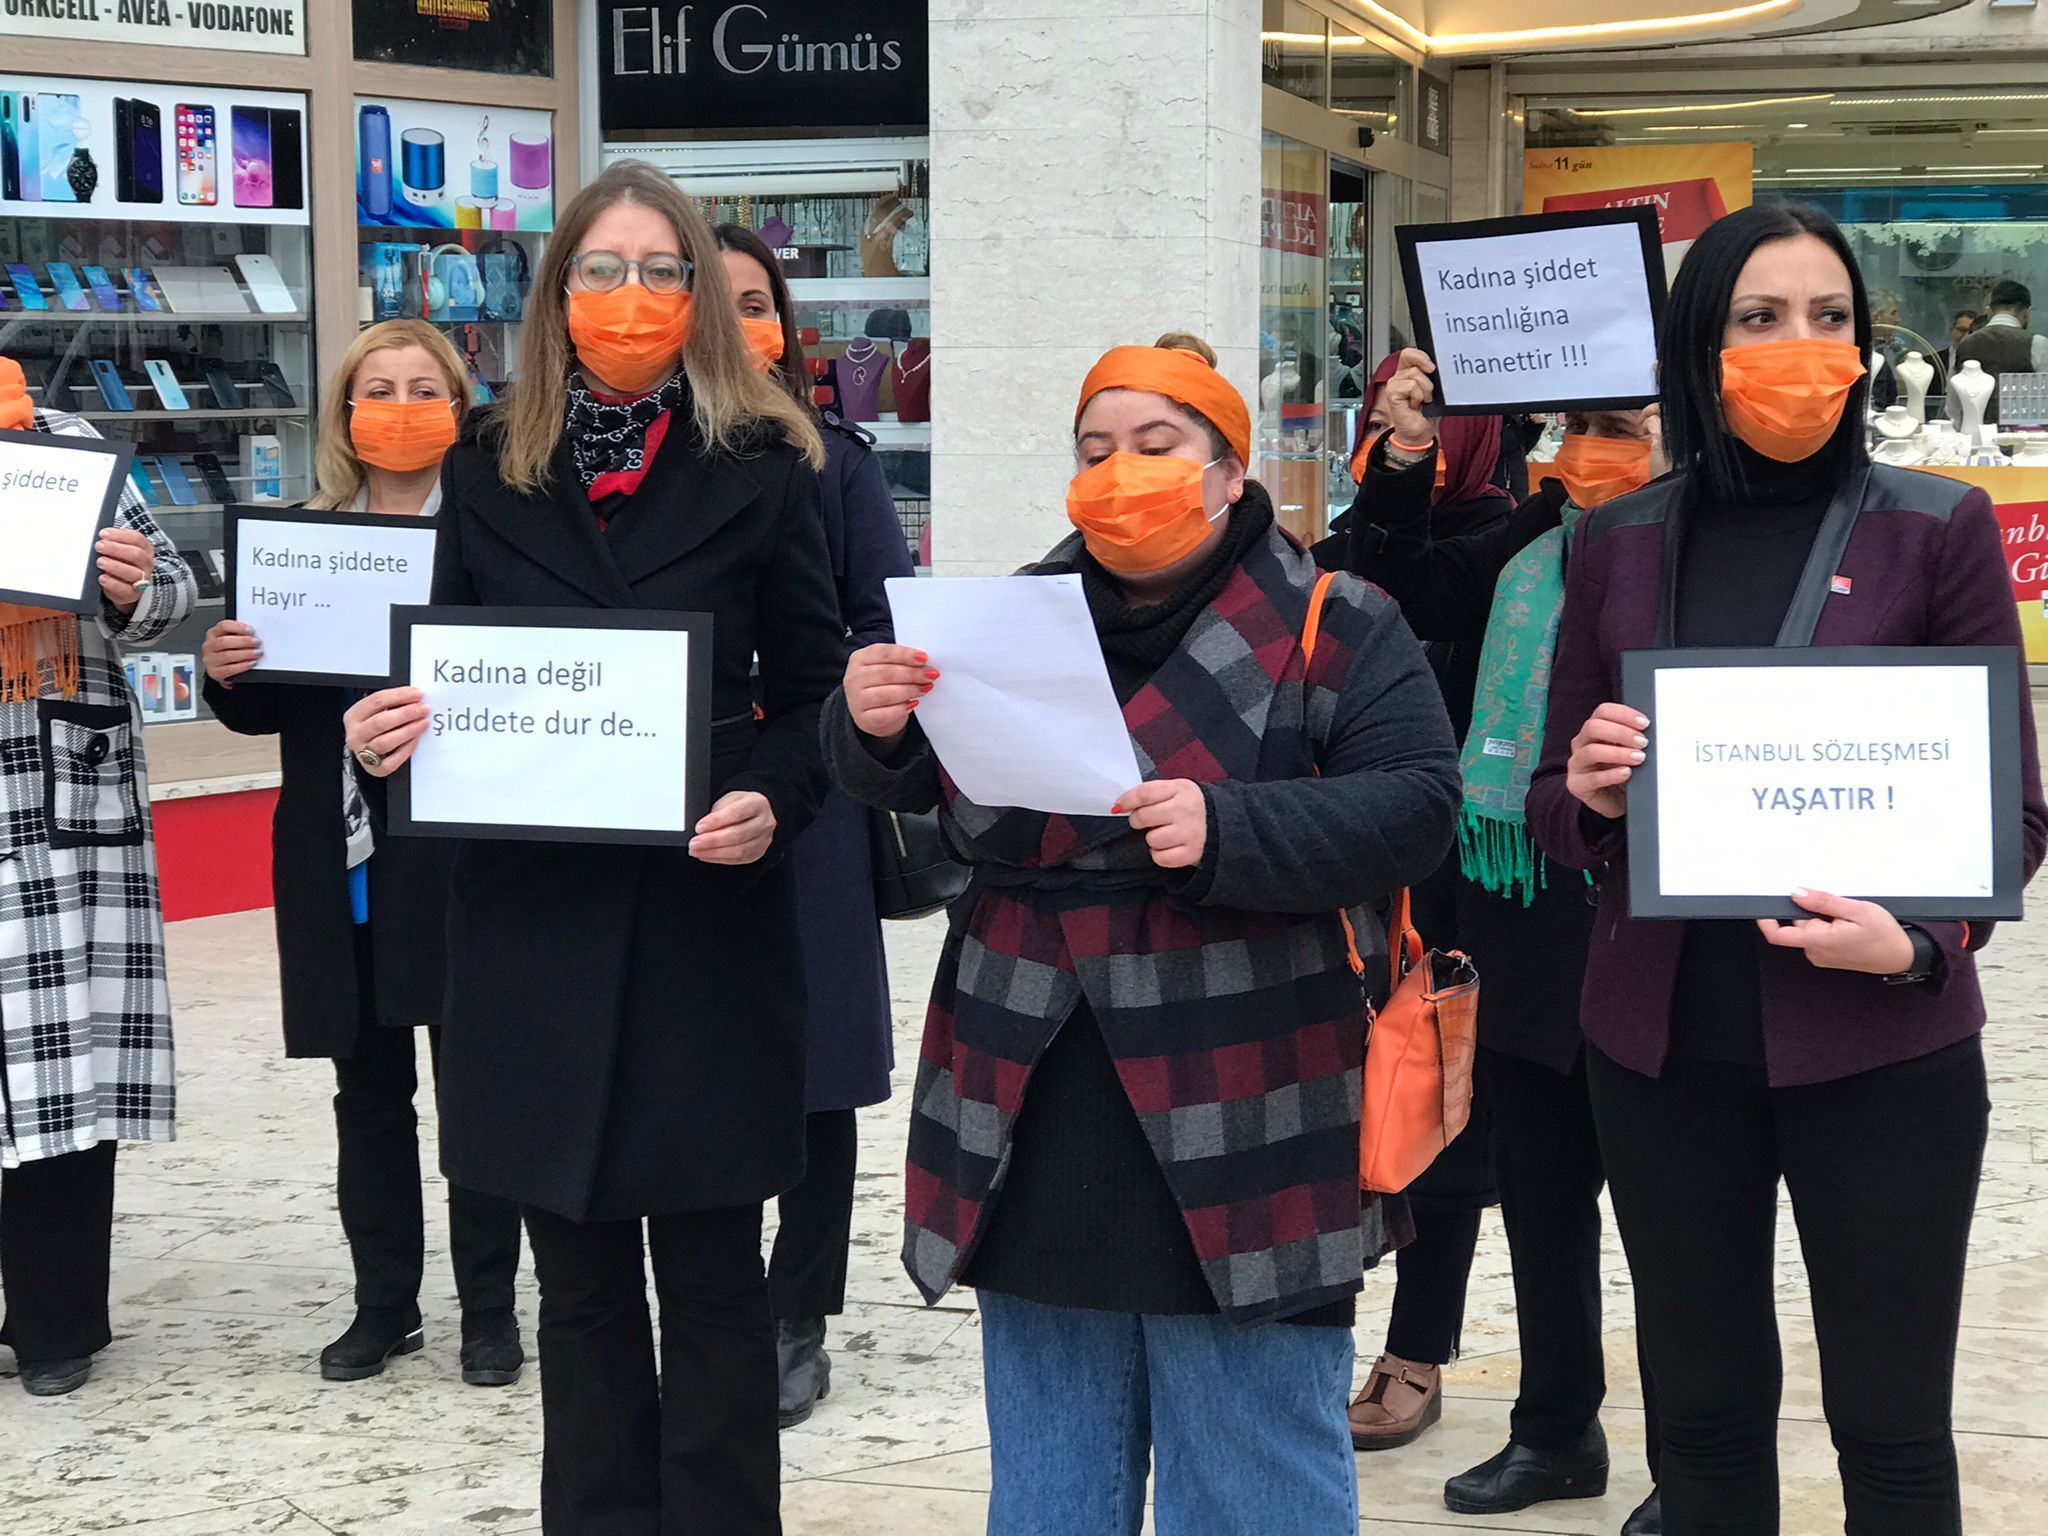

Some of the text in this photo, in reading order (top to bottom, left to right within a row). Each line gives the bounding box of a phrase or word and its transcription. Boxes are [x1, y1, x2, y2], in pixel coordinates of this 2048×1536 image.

[4, 0, 99, 21] URKCELL
[117, 0, 171, 27] AVEA
[187, 2, 295, 36] VODAFONE
[612, 5, 694, 75] Elif
[1554, 157, 1569, 170] 11
[1571, 160, 1593, 173] gün
[1438, 257, 1598, 291] Kadına şiddet
[1445, 306, 1570, 333] insanlığına
[1453, 344, 1588, 375] ihanettir !!!
[2, 469, 79, 493] şiddete
[252, 547, 408, 575] Kadına şiddete
[251, 586, 307, 610] Hayır
[434, 659, 602, 692] Kadına değil
[432, 707, 657, 738] şiddete dur de...
[1695, 738, 1950, 766] İSTANBUL SÖZLEŞMESİ
[1751, 786, 1894, 816] YAŞATIR !
